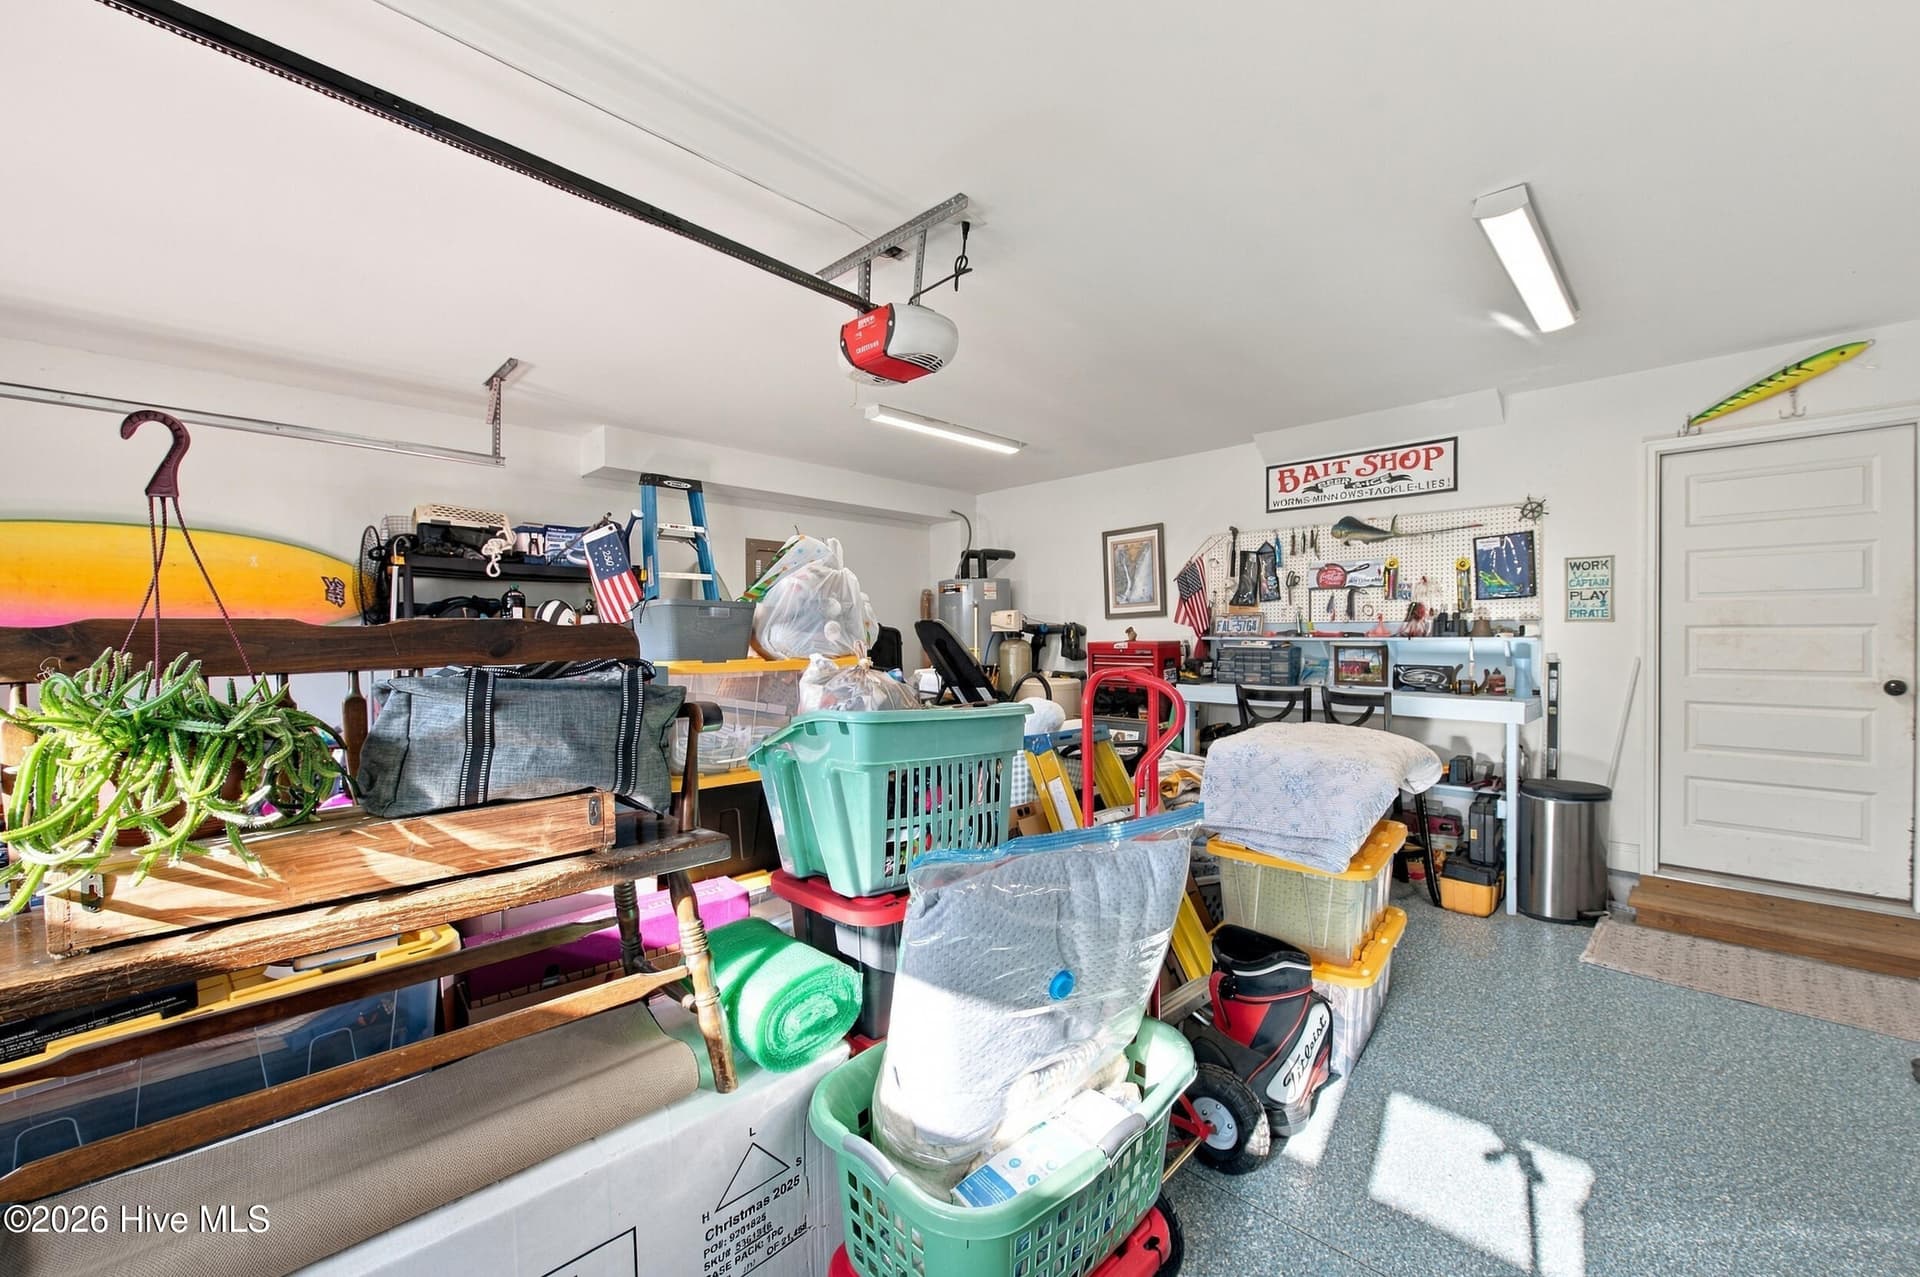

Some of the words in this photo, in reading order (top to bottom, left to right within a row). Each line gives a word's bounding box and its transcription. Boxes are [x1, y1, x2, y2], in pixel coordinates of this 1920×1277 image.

[1278, 459, 1351, 493] BAIT
[1355, 446, 1444, 477] SHOP
[602, 550, 615, 567] 250
[1569, 560, 1609, 571] WORK
[1568, 578, 1609, 587] CAPTAIN
[1569, 591, 1609, 601] PLAY
[1569, 609, 1609, 618] PIRATE
[1283, 1013, 1327, 1099] Titleist
[749, 1127, 757, 1137] L
[795, 1156, 803, 1167] S
[704, 1196, 770, 1242] Christmas
[772, 1174, 800, 1201] 2025
[702, 1211, 710, 1225] H
[705, 1260, 732, 1277] ASE
[734, 1240, 764, 1266] PACK:
[766, 1225, 784, 1243] 1PC
[766, 1240, 780, 1256] OF
